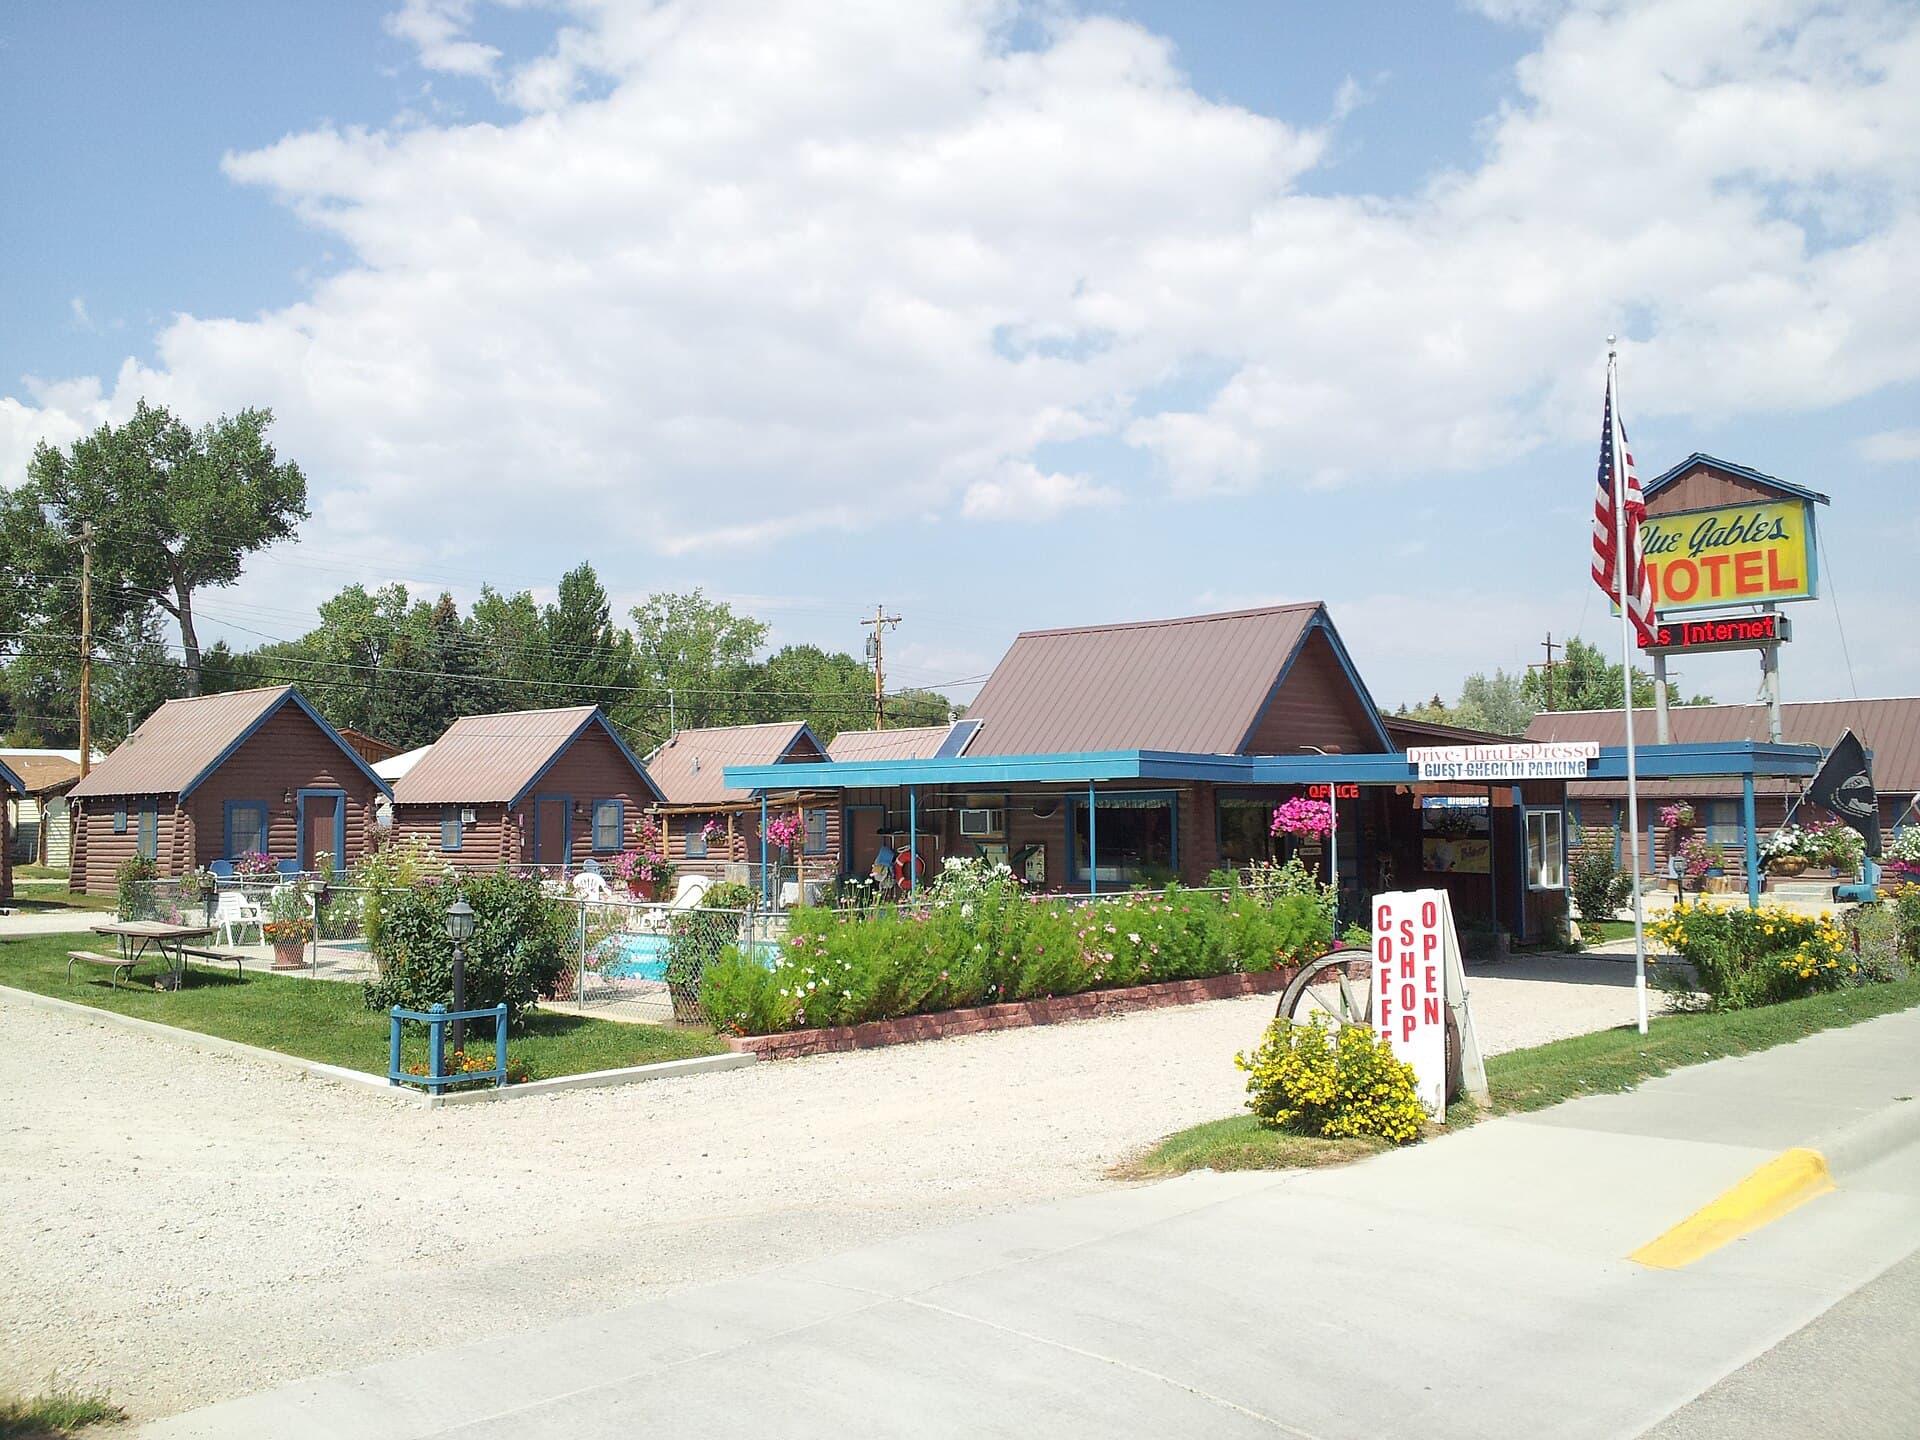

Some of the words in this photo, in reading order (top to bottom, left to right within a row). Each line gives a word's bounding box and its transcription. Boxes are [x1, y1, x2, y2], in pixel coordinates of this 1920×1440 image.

[1688, 513, 1789, 557] Gables
[1639, 628, 1672, 647] es
[1683, 617, 1774, 646] Internet
[1424, 763, 1463, 777] GUEST
[1511, 762, 1524, 776] IN
[1528, 761, 1586, 776] PARKING
[1309, 784, 1360, 798] OFICE
[1400, 919, 1417, 1043] SHOP
[1422, 902, 1439, 1024] OPEN
